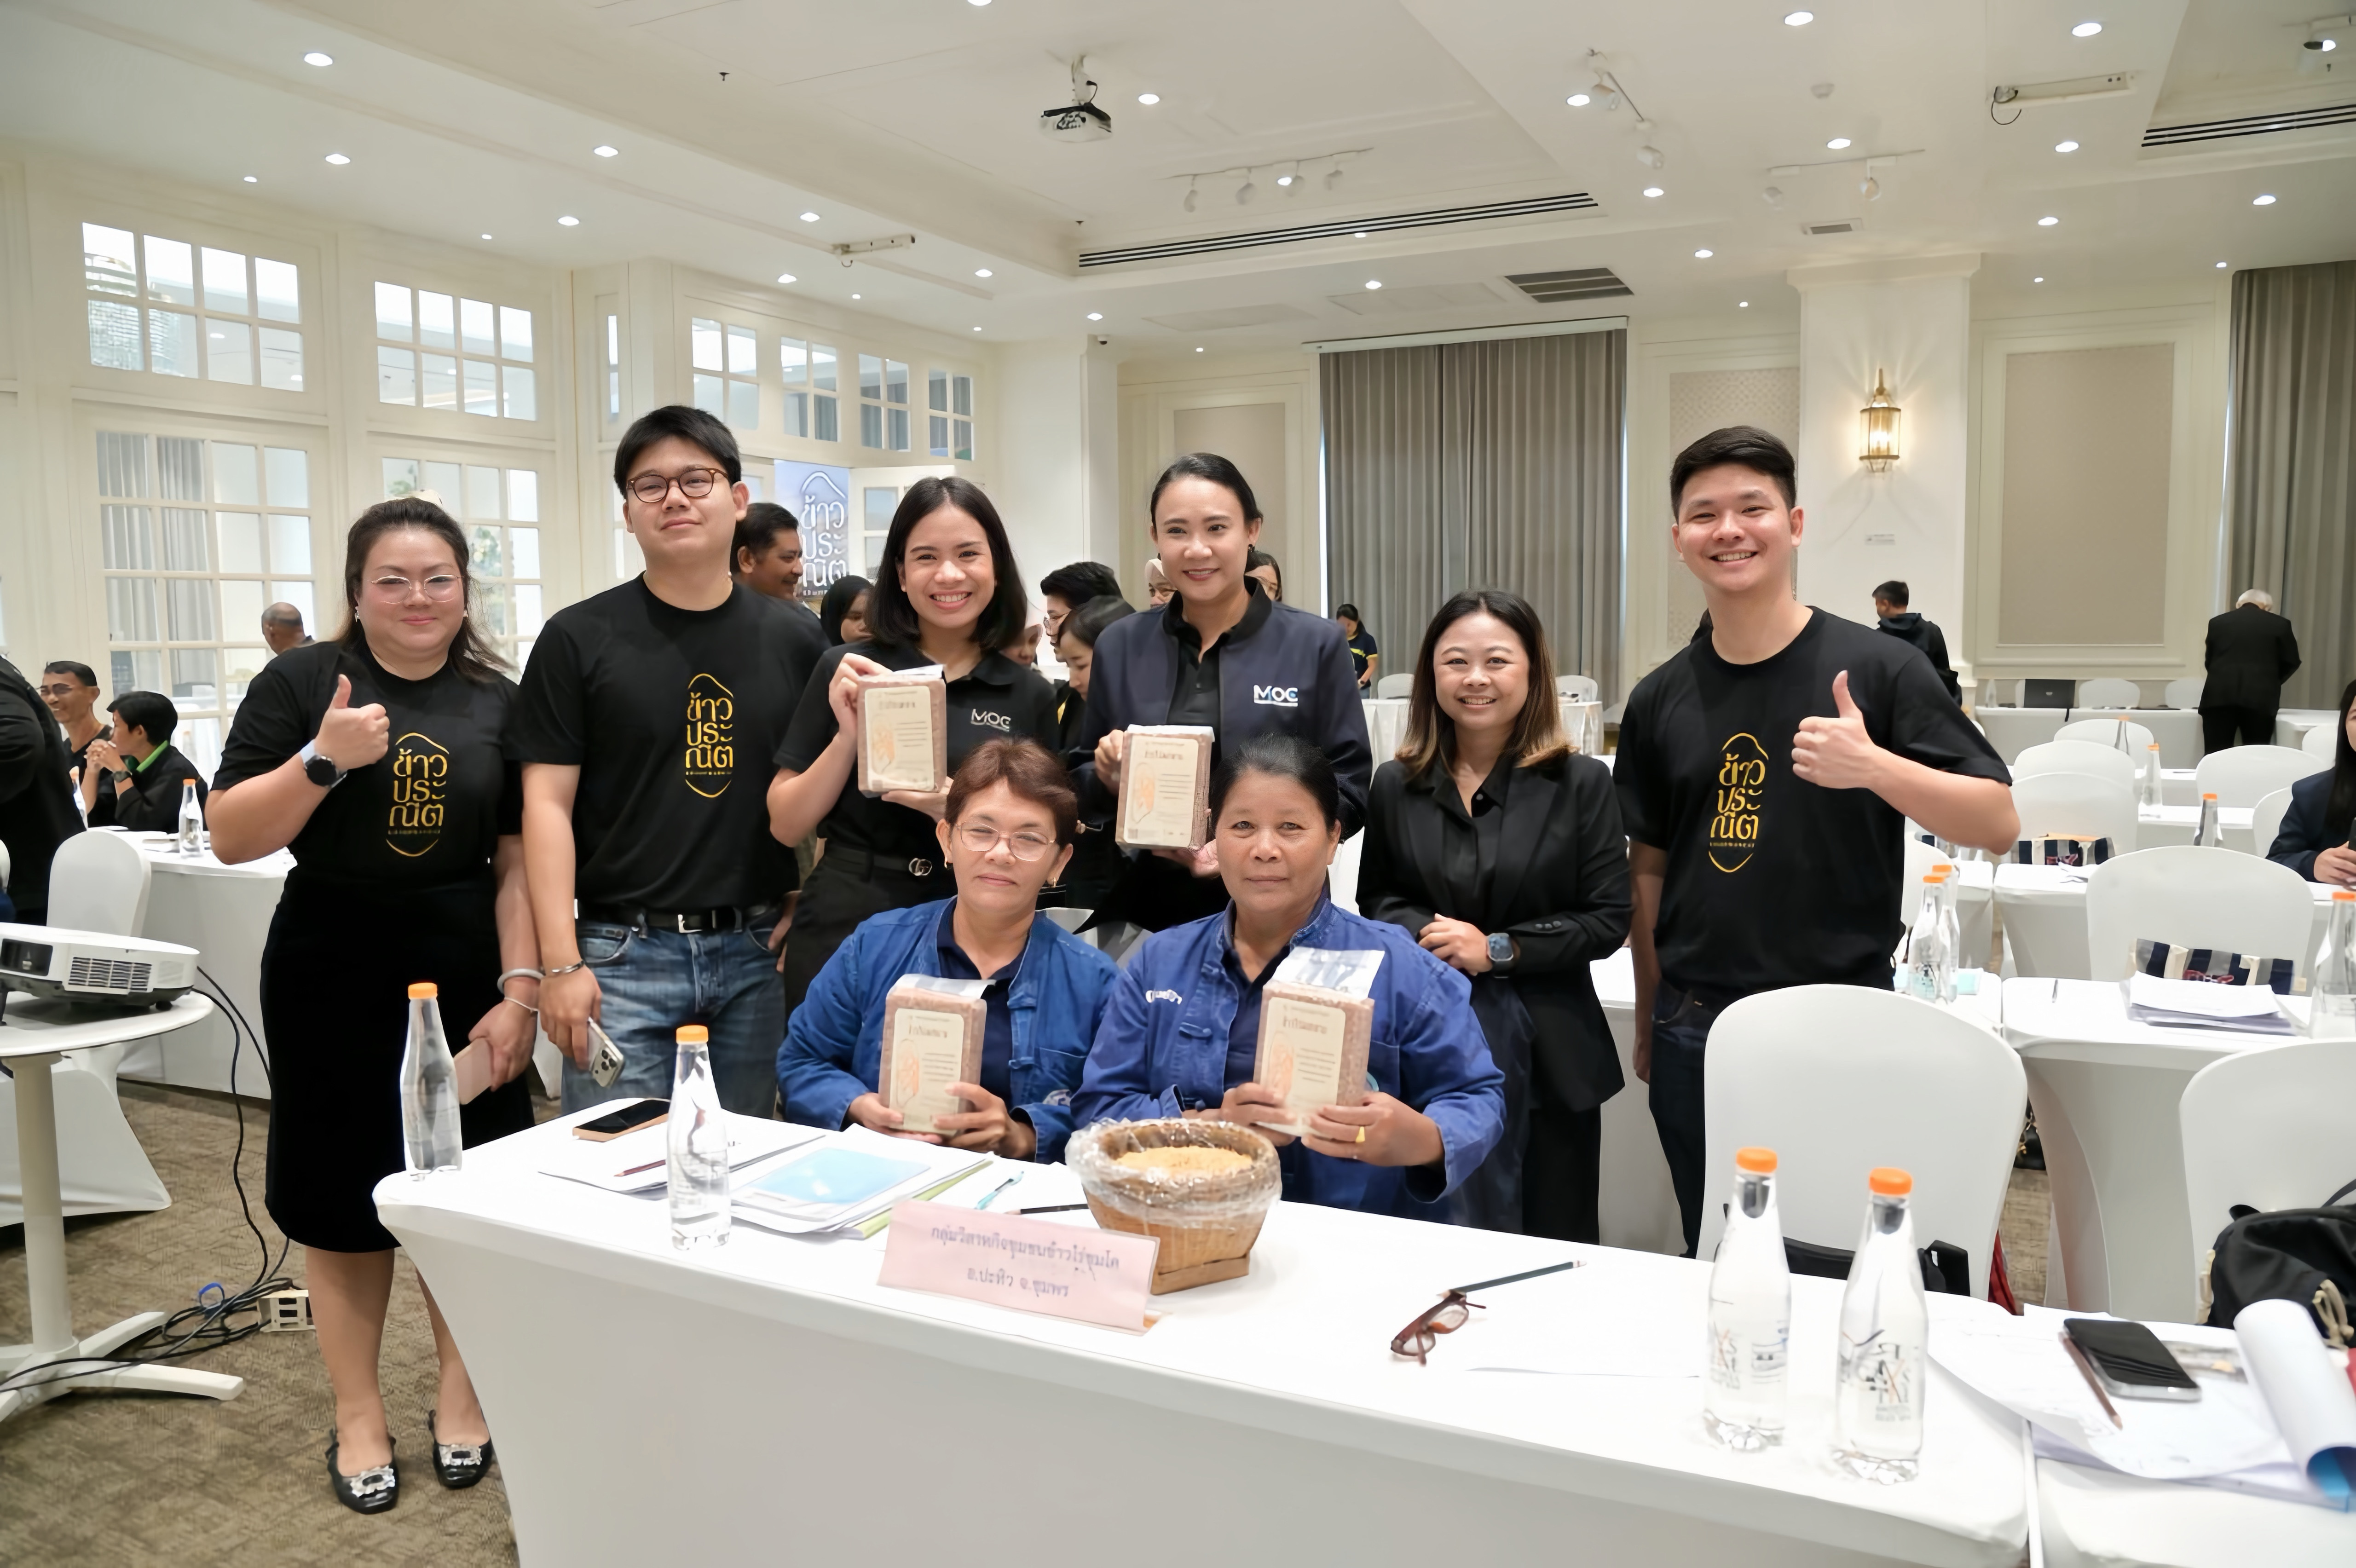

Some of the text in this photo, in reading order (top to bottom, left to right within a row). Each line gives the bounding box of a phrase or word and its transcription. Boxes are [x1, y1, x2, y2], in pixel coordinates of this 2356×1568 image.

[800, 495, 845, 530] ข้าว
[802, 530, 846, 559] ประ
[687, 692, 733, 722] ข้าว
[1253, 684, 1298, 702] MOC
[971, 709, 1011, 729] MOC
[687, 721, 733, 746] ประ
[393, 748, 448, 778] ข้าว
[1719, 753, 1766, 786] ข้าว
[393, 778, 447, 803] ประ
[1717, 786, 1763, 813] ประ
